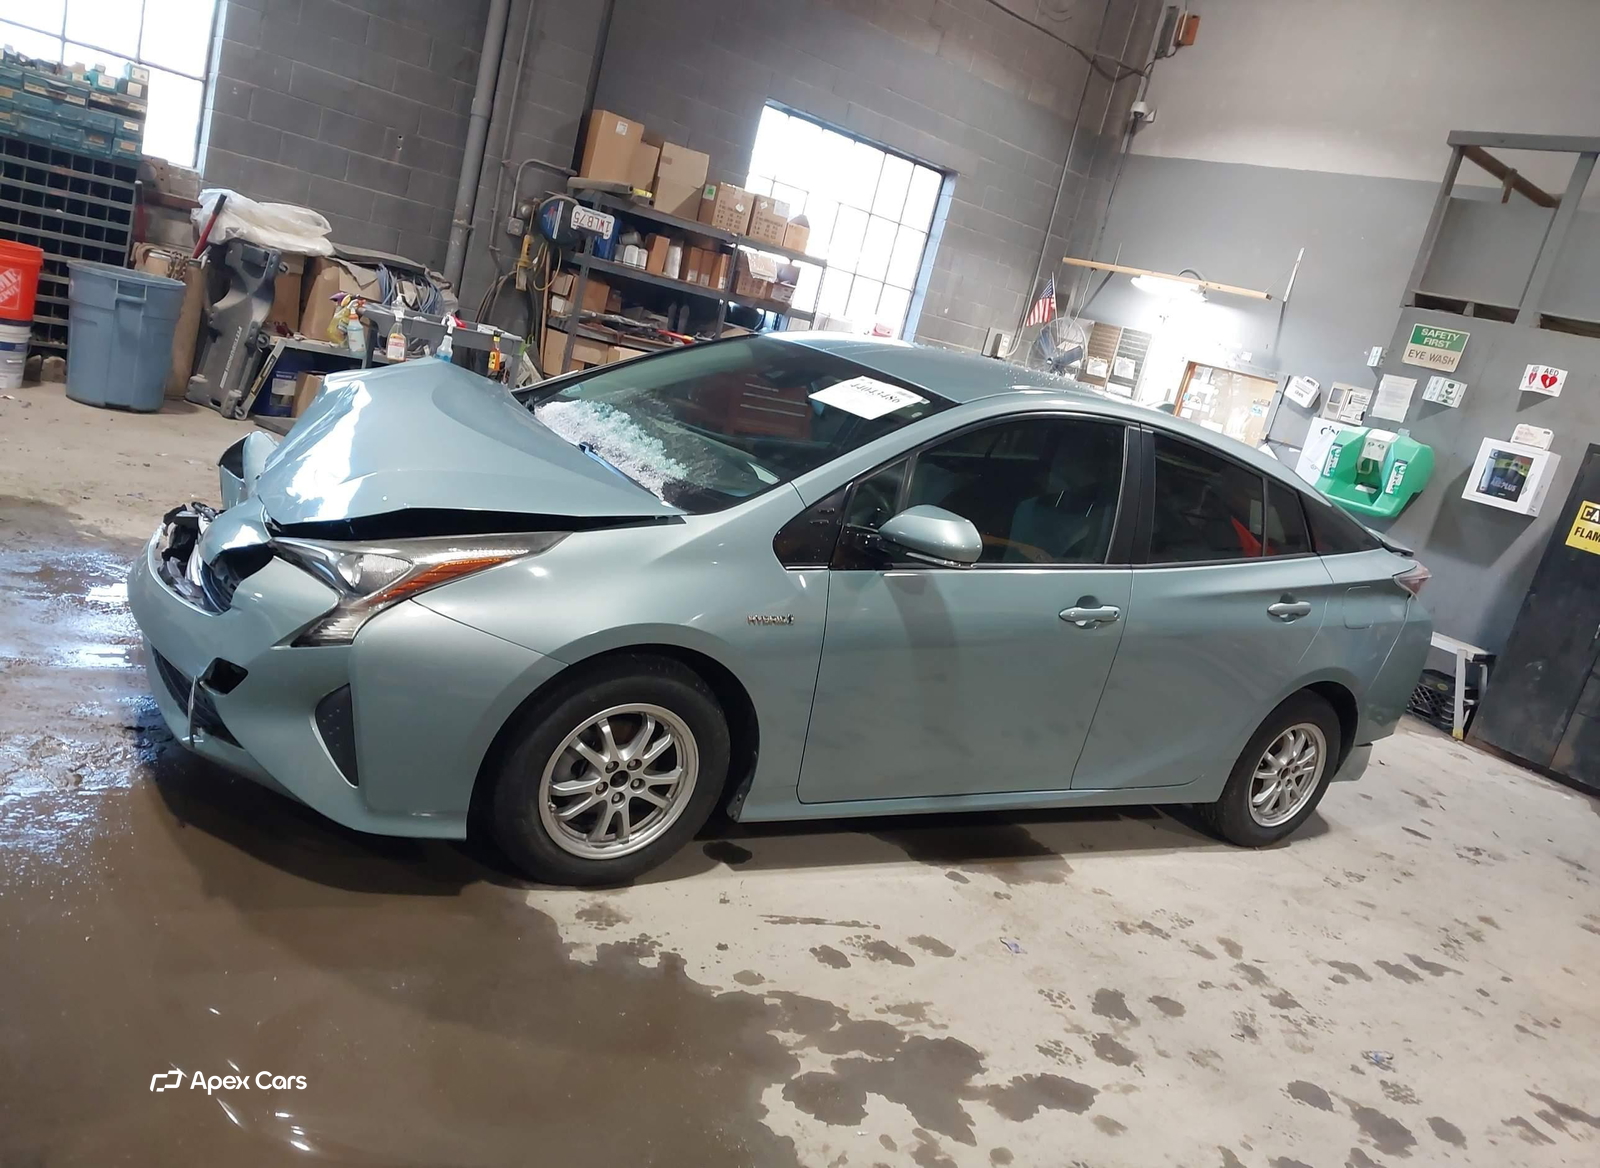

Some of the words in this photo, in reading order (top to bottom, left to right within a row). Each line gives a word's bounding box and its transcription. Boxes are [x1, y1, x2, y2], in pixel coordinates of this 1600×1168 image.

[1421, 328, 1460, 341] SAFETY
[1423, 337, 1452, 348] FIRST
[1408, 349, 1426, 360] EYE
[1429, 353, 1456, 365] WASH
[1544, 368, 1559, 376] AED
[1500, 481, 1517, 492] PLUS
